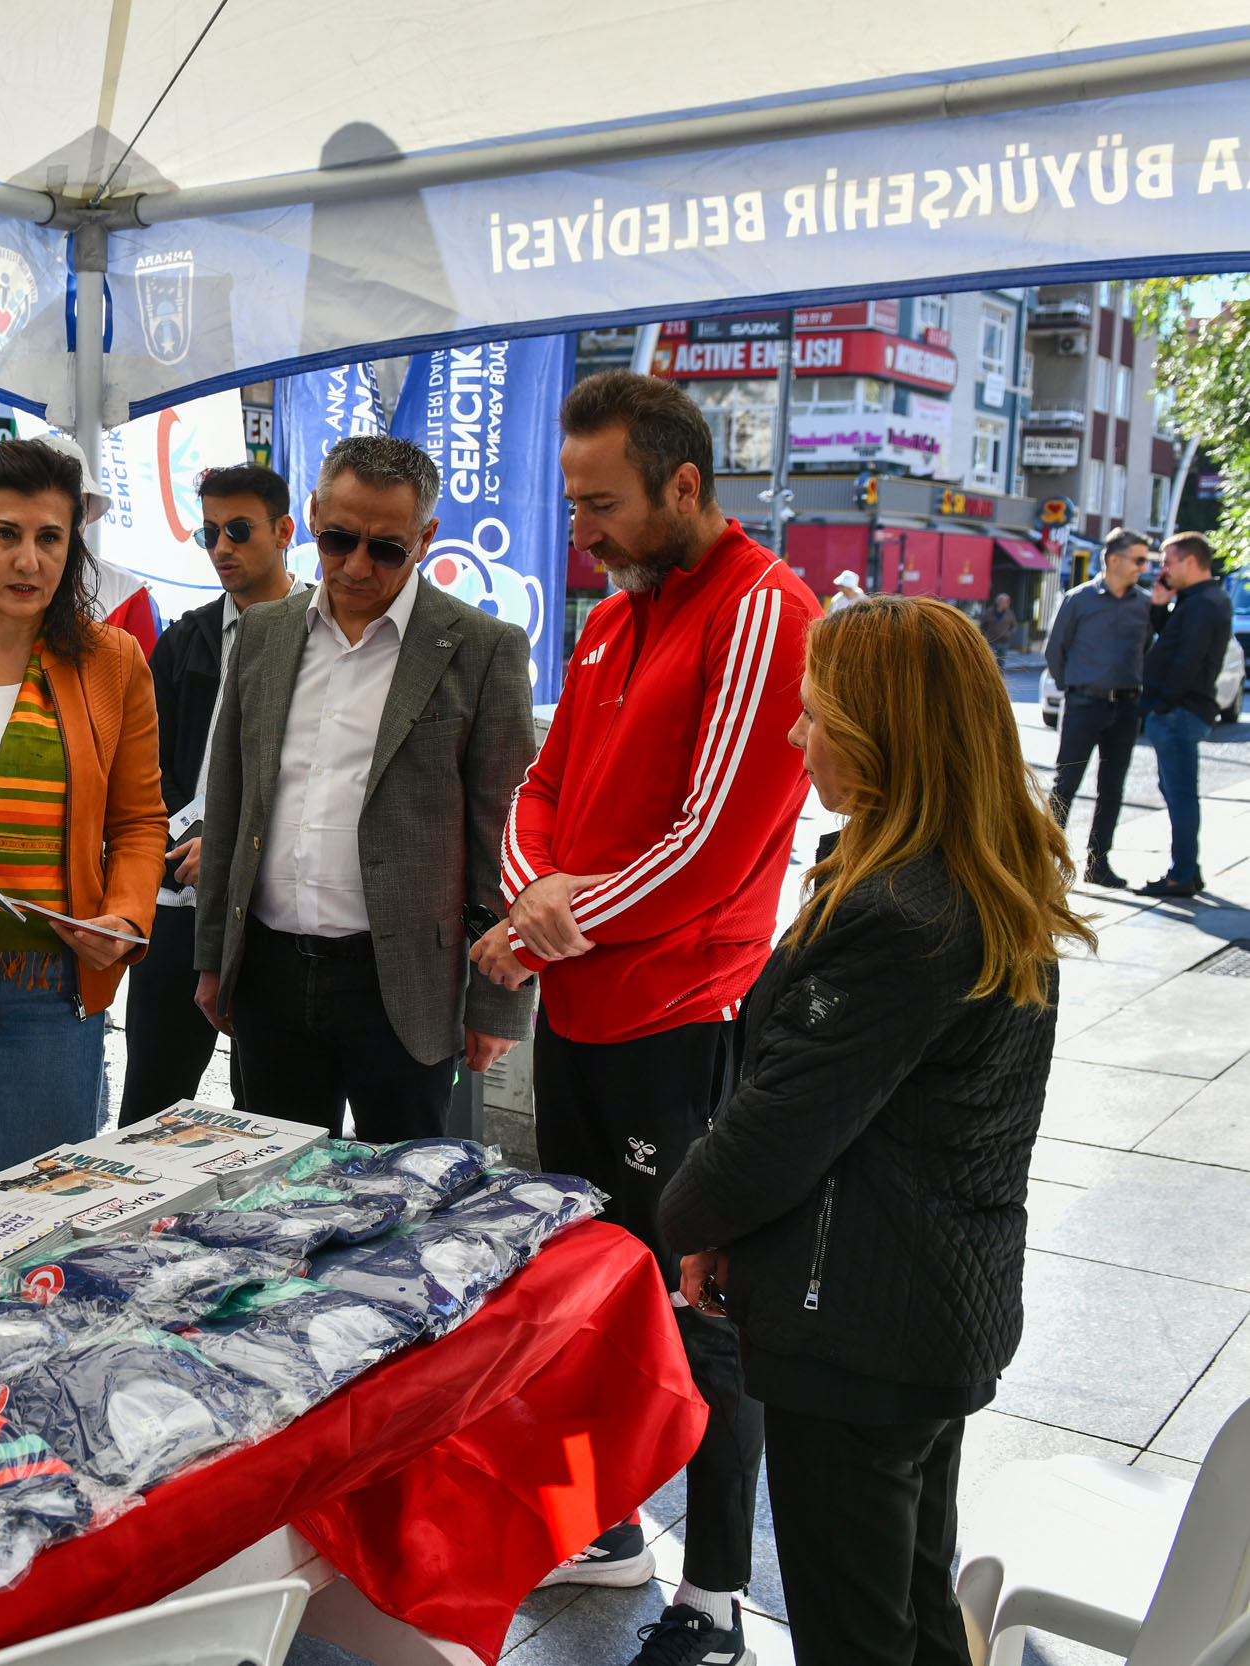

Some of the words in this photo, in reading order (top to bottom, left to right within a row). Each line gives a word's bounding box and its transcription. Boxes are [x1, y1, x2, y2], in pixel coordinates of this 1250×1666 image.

[730, 321, 781, 336] SAZAK
[674, 343, 746, 372] ACTIVE
[751, 337, 843, 370] ENLISH
[243, 411, 272, 446] ER
[624, 1153, 657, 1176] hummel
